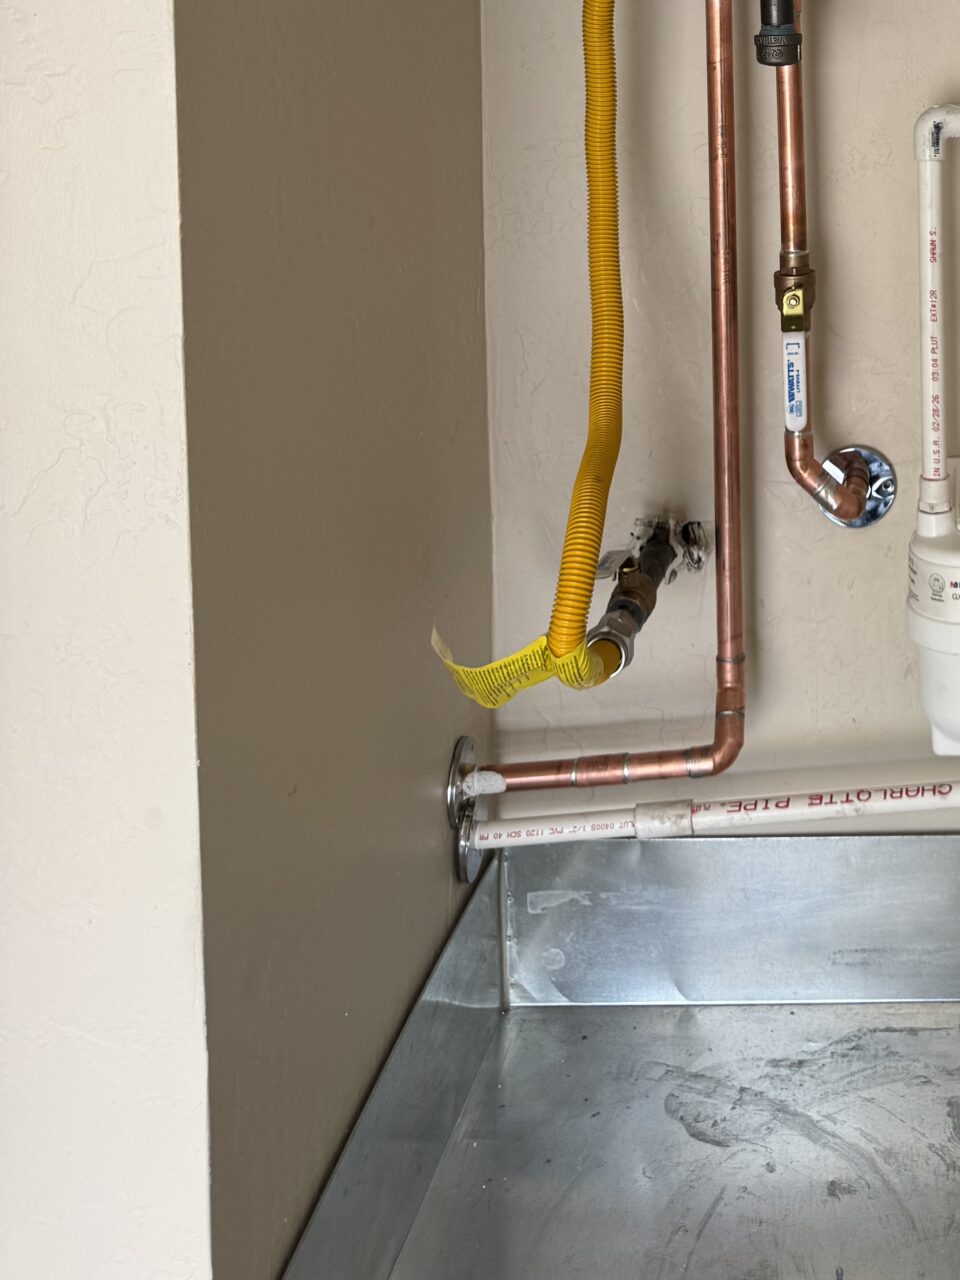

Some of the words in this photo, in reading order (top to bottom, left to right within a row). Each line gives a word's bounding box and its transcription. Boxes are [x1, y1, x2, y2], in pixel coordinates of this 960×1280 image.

[786, 361, 795, 400] WATTS
[933, 467, 941, 477] IN
[807, 783, 953, 807] CHARLOTTE
[506, 830, 522, 839] SCH
[549, 825, 564, 835] PVC
[493, 831, 503, 840] 40
